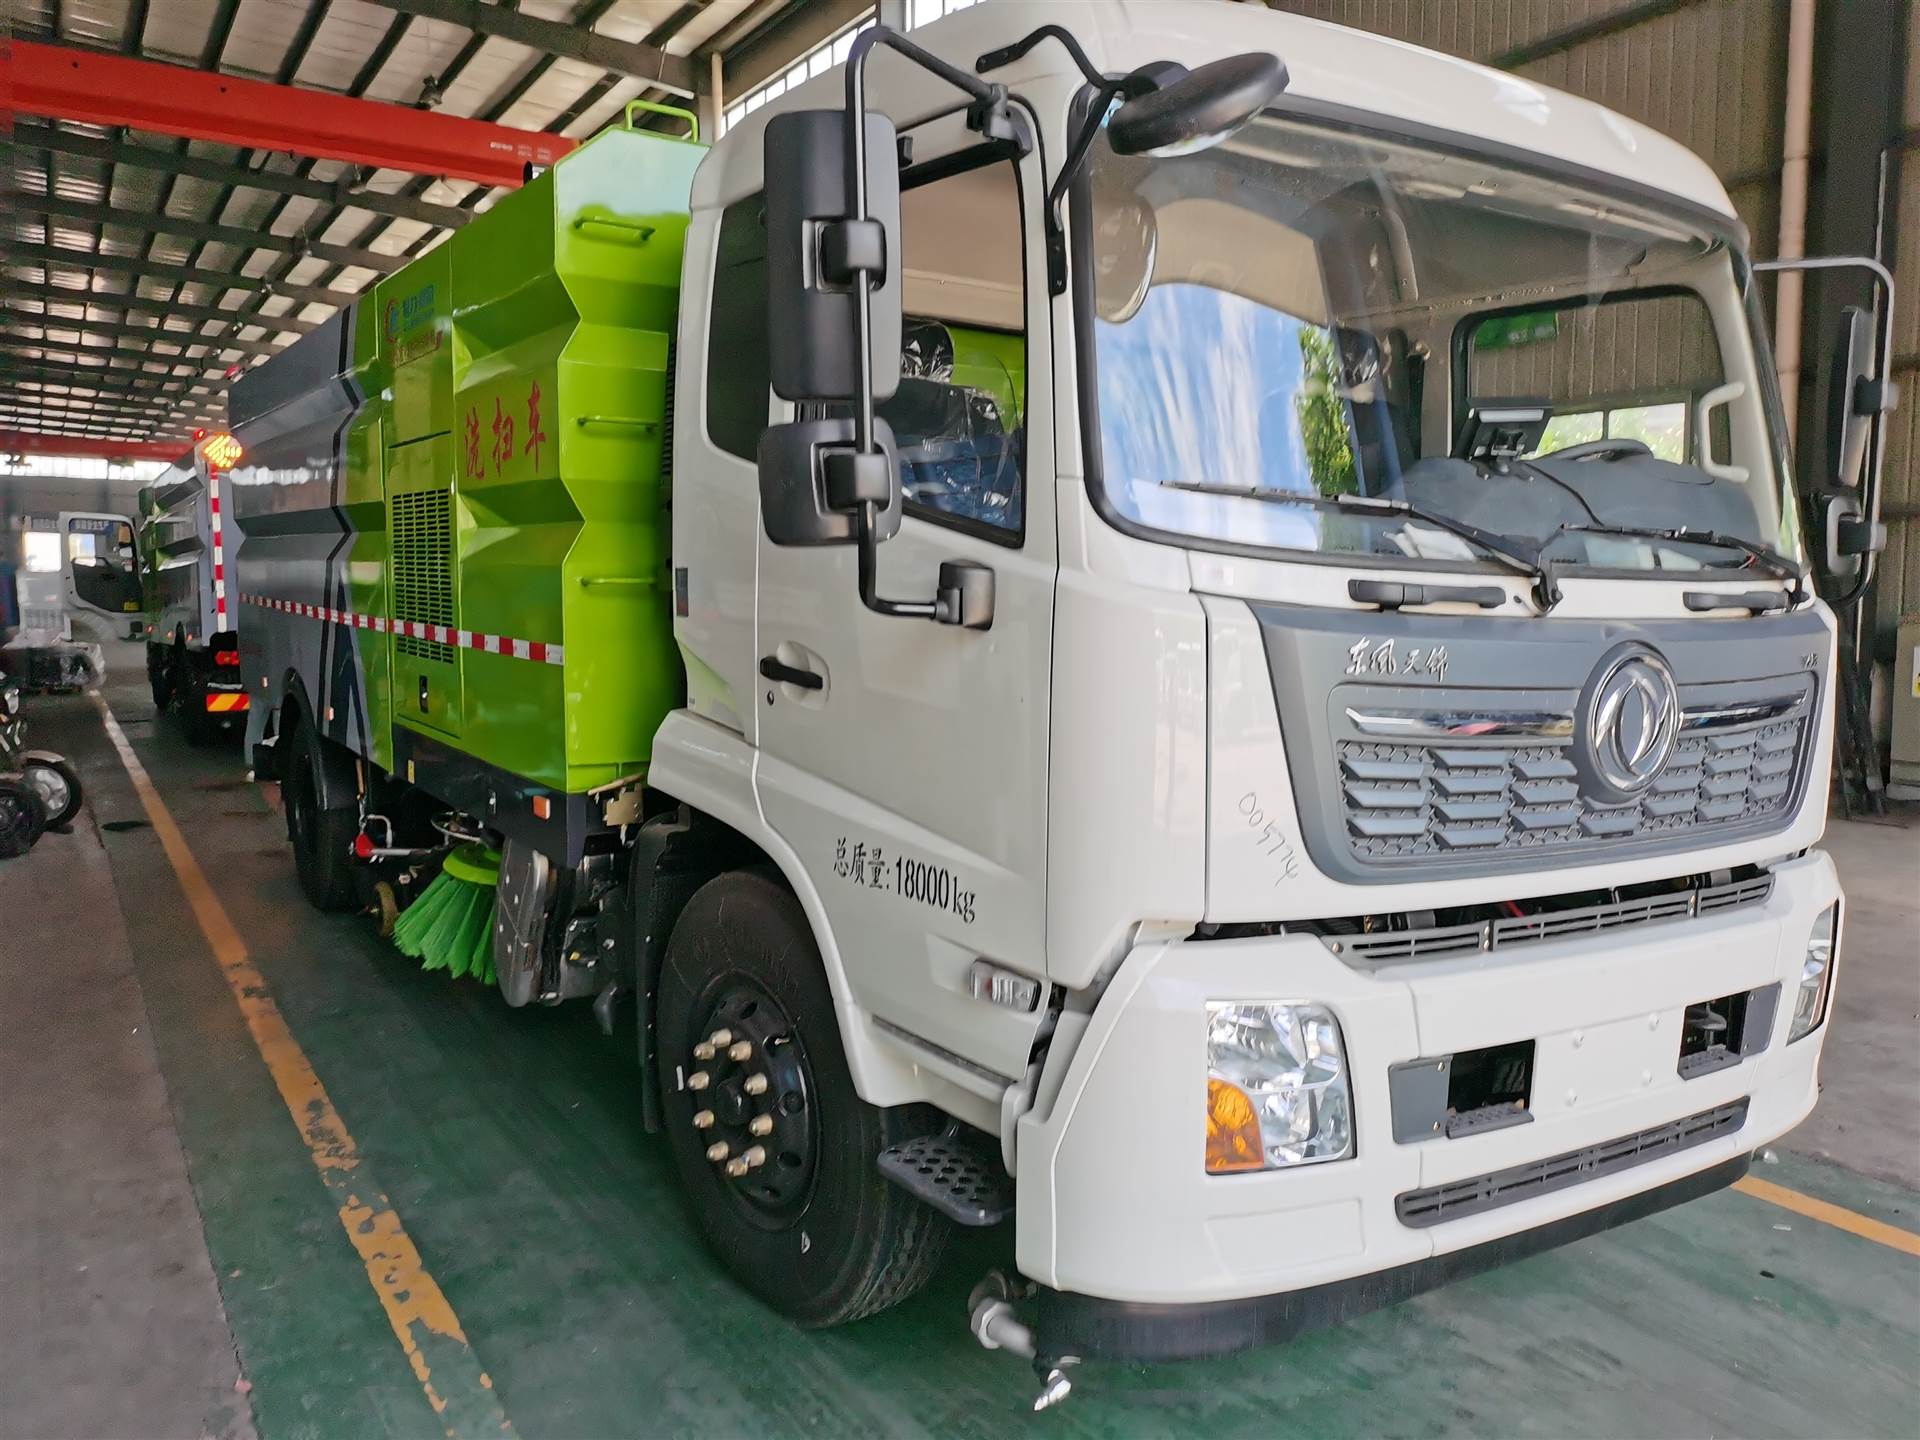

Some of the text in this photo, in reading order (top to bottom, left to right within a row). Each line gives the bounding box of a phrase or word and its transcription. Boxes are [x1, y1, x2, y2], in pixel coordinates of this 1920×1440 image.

[464, 380, 546, 480] 洗扫车
[1345, 636, 1449, 682] 东风天锦
